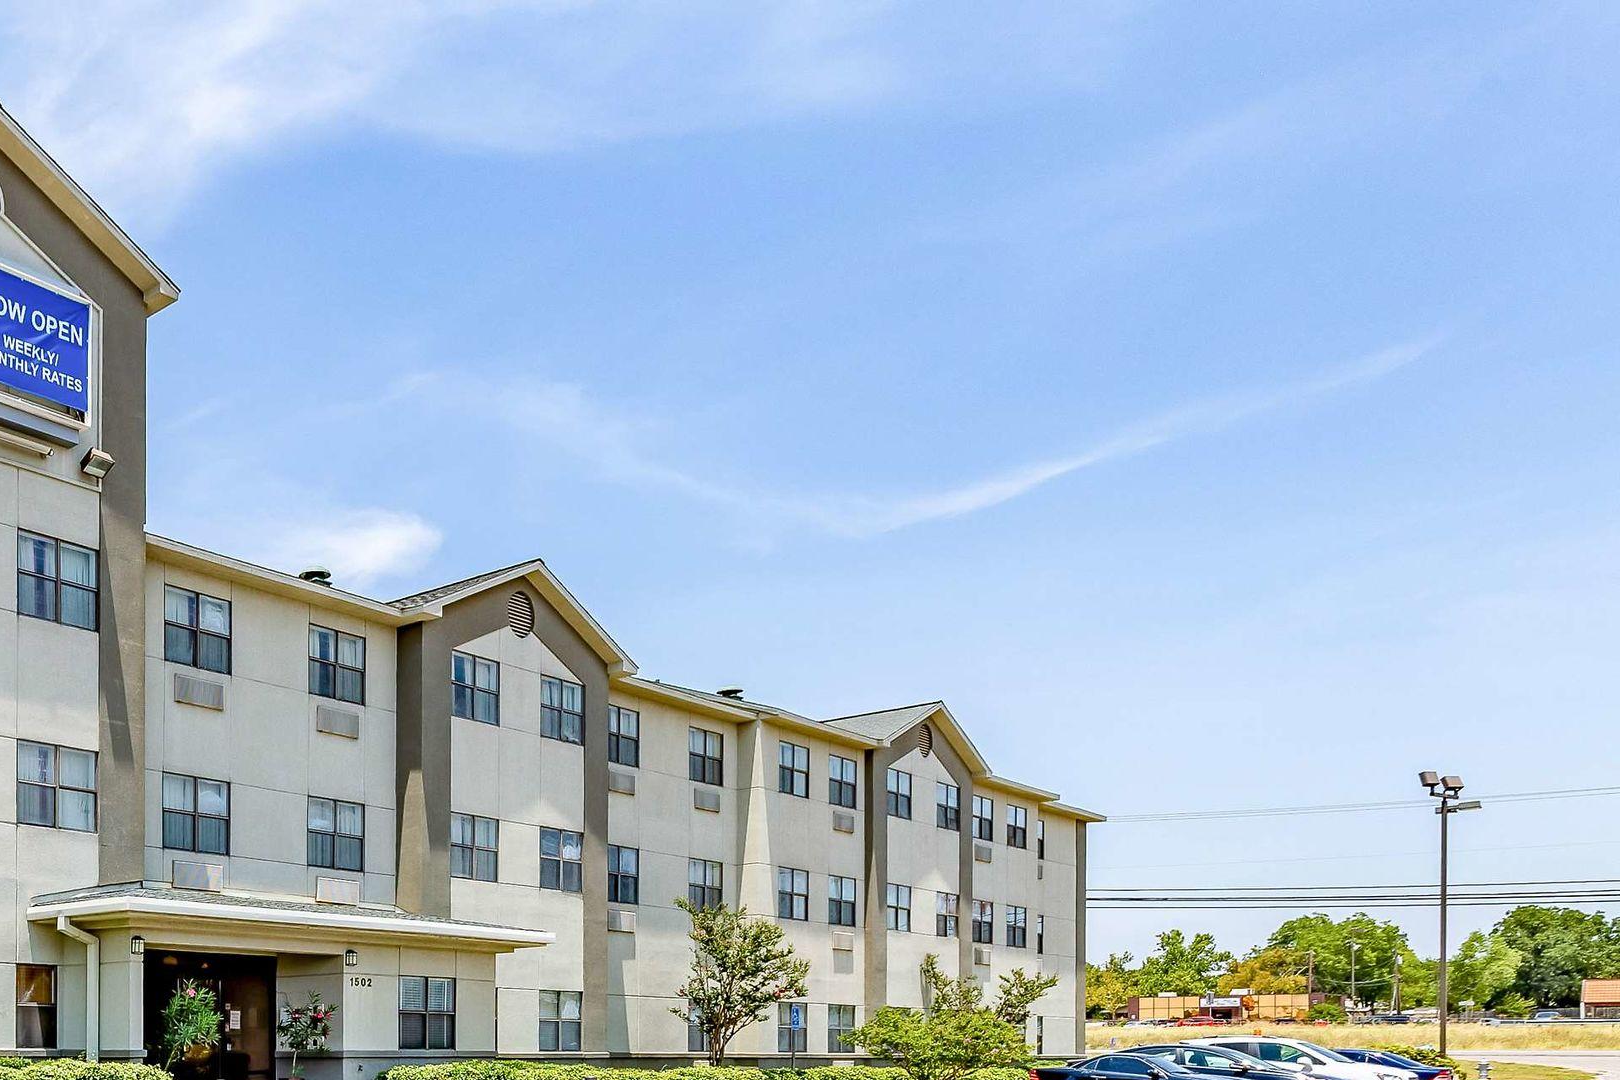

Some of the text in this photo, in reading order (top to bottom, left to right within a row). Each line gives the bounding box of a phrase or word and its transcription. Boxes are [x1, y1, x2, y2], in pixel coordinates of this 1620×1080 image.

[31, 310, 83, 347] OPEN
[3, 334, 59, 367] WEEKLY/
[42, 367, 83, 393] RATES
[349, 977, 372, 988] 1502
